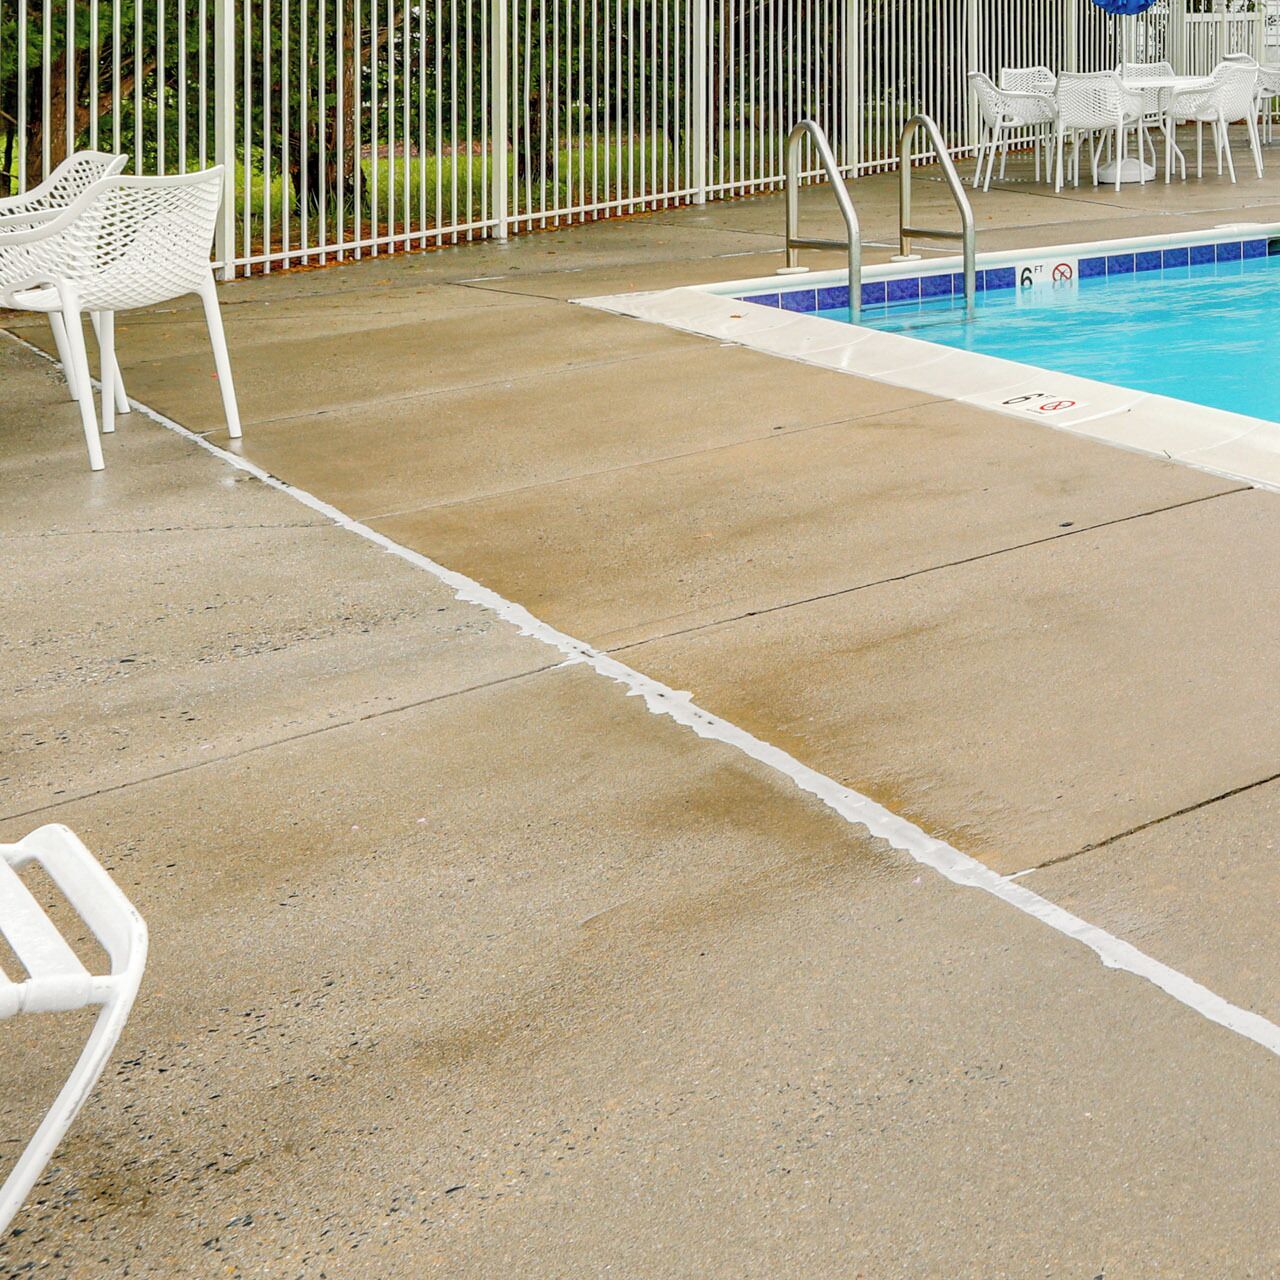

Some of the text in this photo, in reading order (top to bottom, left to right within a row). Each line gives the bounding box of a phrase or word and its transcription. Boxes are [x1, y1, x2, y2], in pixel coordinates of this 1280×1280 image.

[1020, 265, 1043, 286] 6 FT
[1002, 393, 1044, 405] 6
